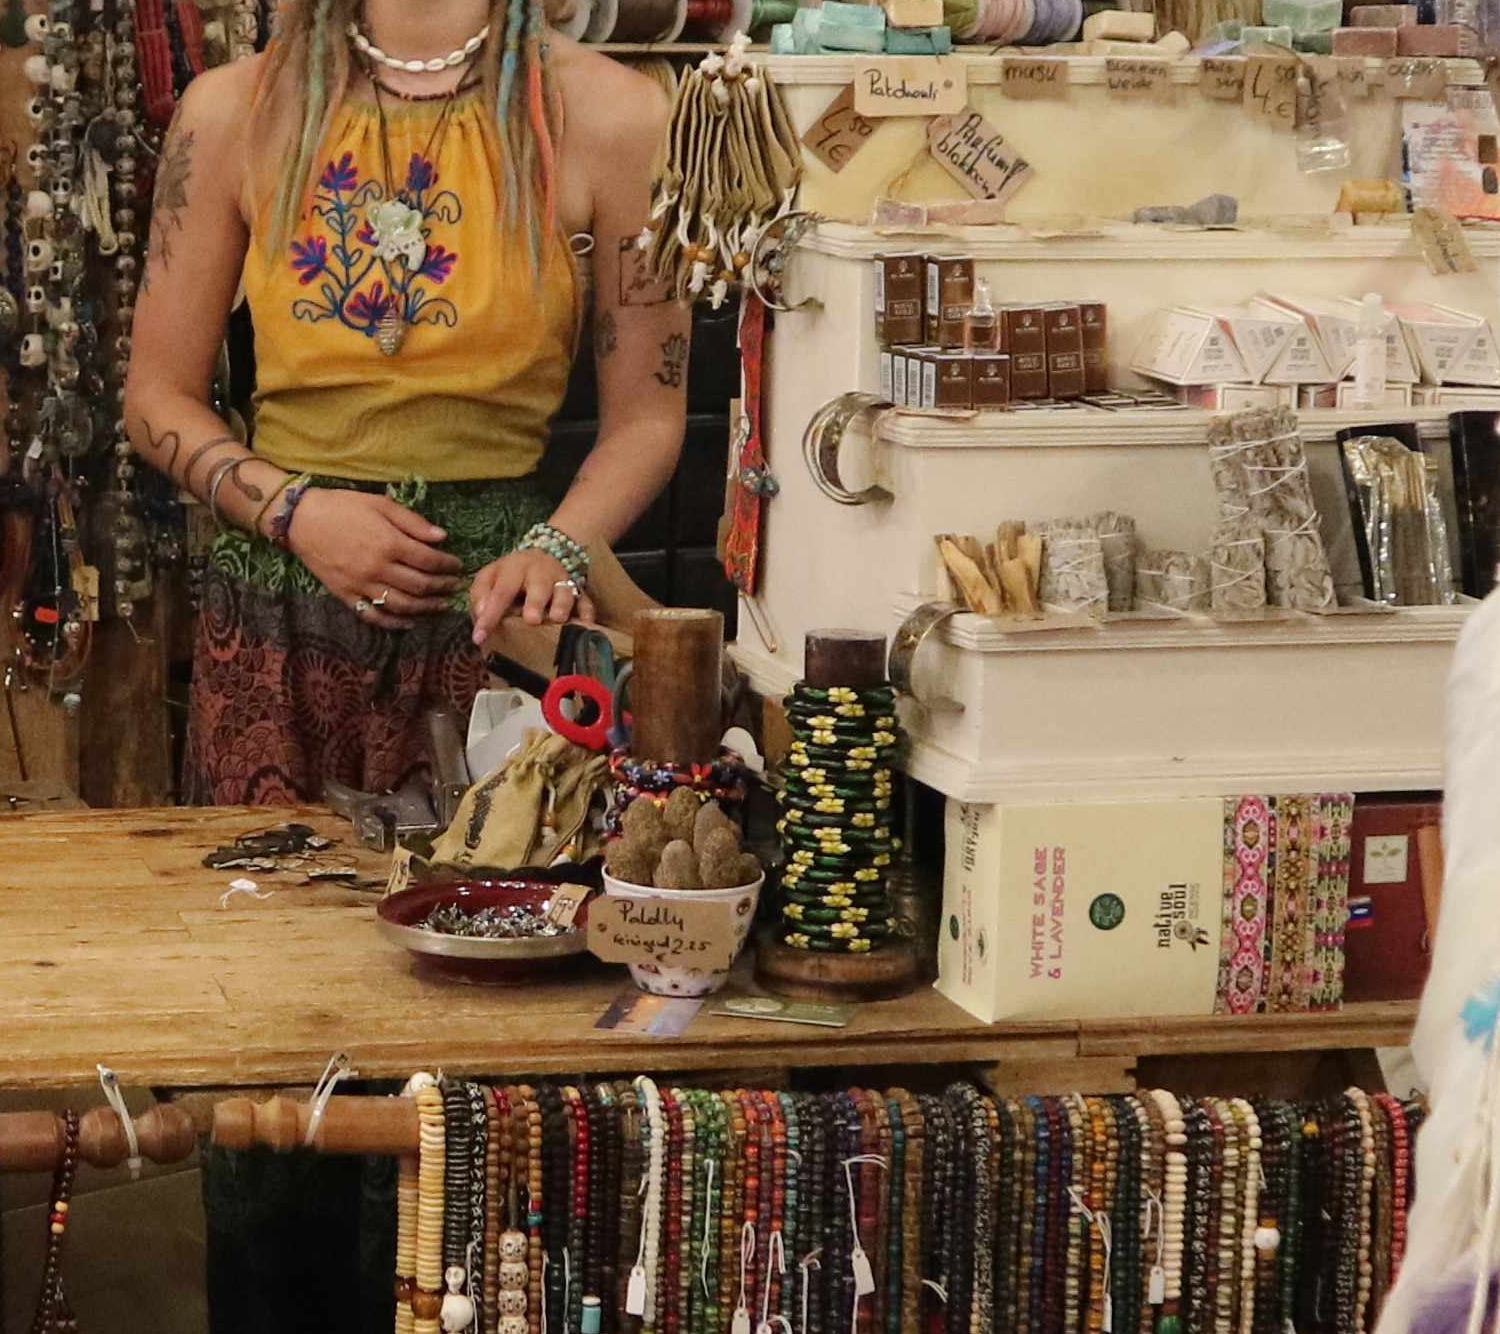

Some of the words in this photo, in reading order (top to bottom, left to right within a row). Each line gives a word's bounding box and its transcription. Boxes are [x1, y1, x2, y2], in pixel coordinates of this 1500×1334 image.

[1033, 847, 1048, 906] SAGE
[1049, 846, 1066, 961] LAVENDER
[1030, 913, 1047, 979] WHITE
[1153, 892, 1174, 949] native
